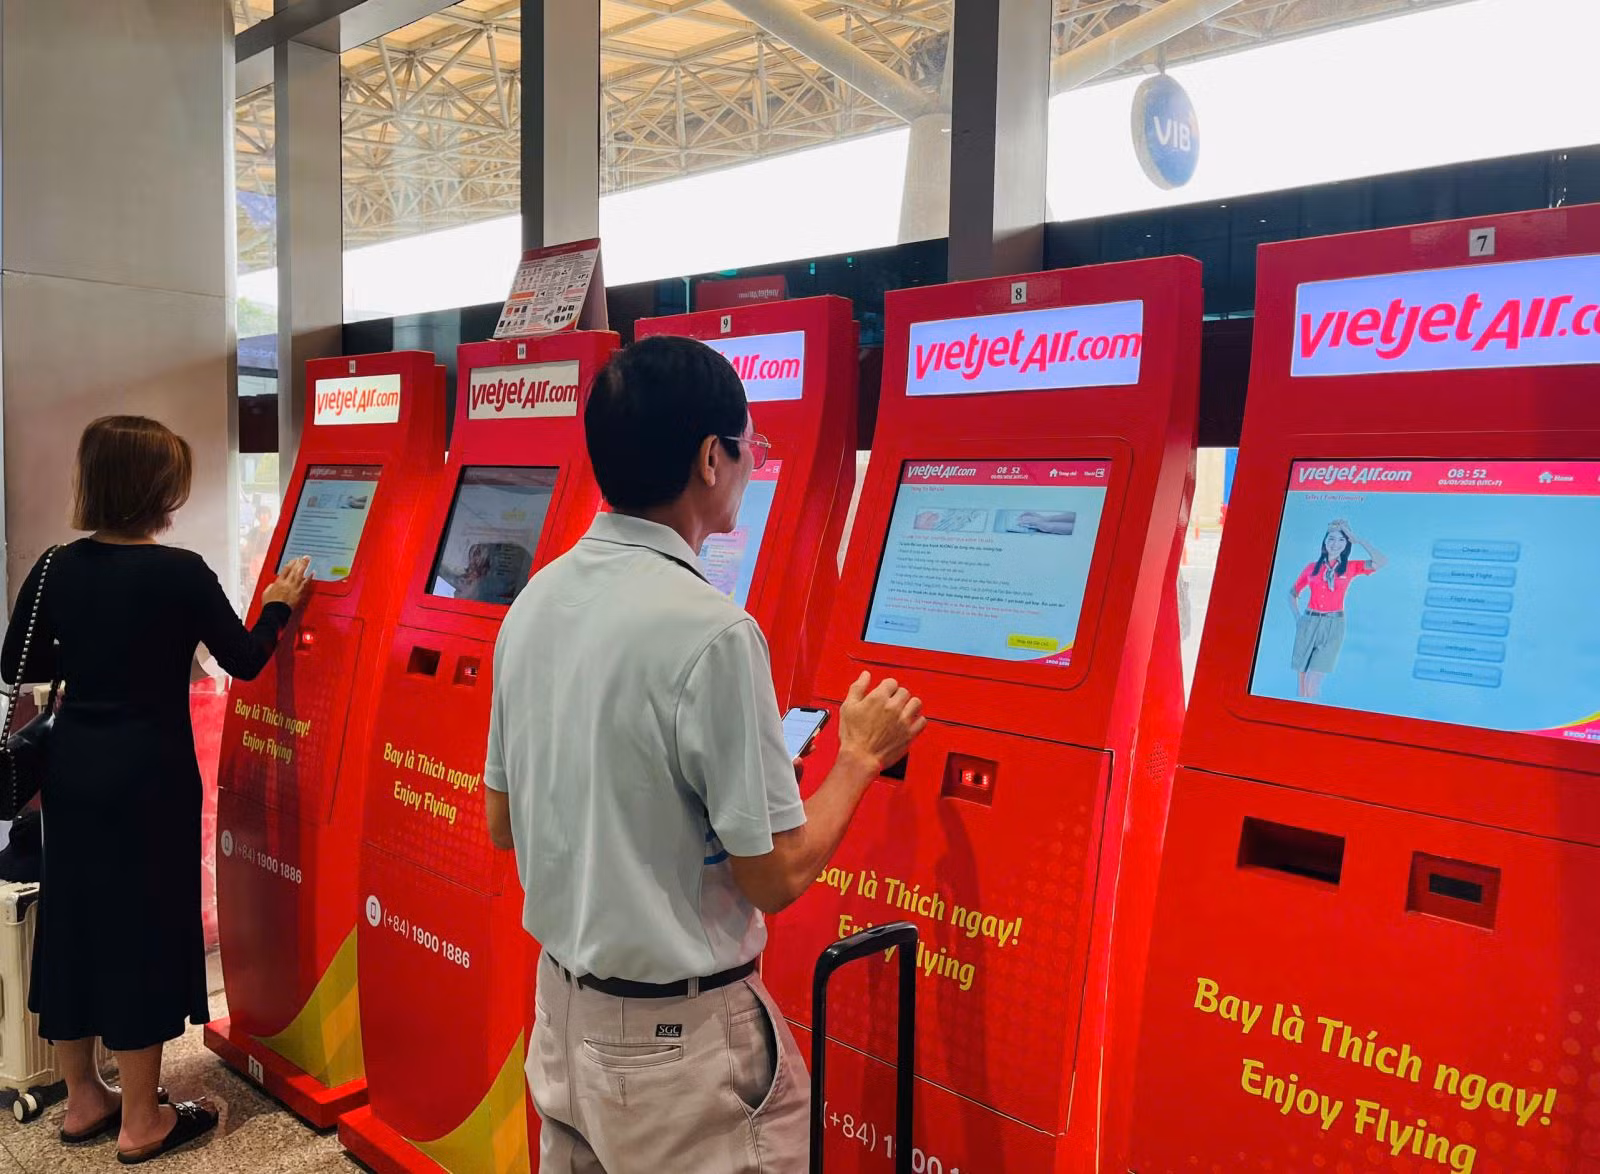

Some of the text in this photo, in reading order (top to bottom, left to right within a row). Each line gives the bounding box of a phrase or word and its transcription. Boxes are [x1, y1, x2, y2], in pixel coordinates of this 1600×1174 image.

[1153, 116, 1191, 152] VIB
[1476, 235, 1488, 252] 7
[1015, 287, 1023, 301] 8
[723, 318, 729, 329] 9
[1300, 293, 1600, 359] VietjetAir.c
[235, 698, 311, 737] Bay là Thích ngay!
[242, 730, 293, 764] Enjoy Flying
[383, 742, 480, 792] Bay là Thích ngay!
[393, 781, 457, 825] Enjoy Flying
[234, 842, 302, 884] (+84) 1900 1886
[857, 870, 878, 899] là
[885, 877, 945, 921] Thích
[951, 904, 1022, 948] ngay!
[383, 908, 470, 969] (+84) 1900 1886
[916, 938, 976, 991] lying
[659, 1025, 680, 1034] SGC
[250, 1060, 261, 1080] 11
[1194, 977, 1557, 1127] Bay là Thích ngay!
[1241, 1058, 1476, 1174] Enjoy Flying
